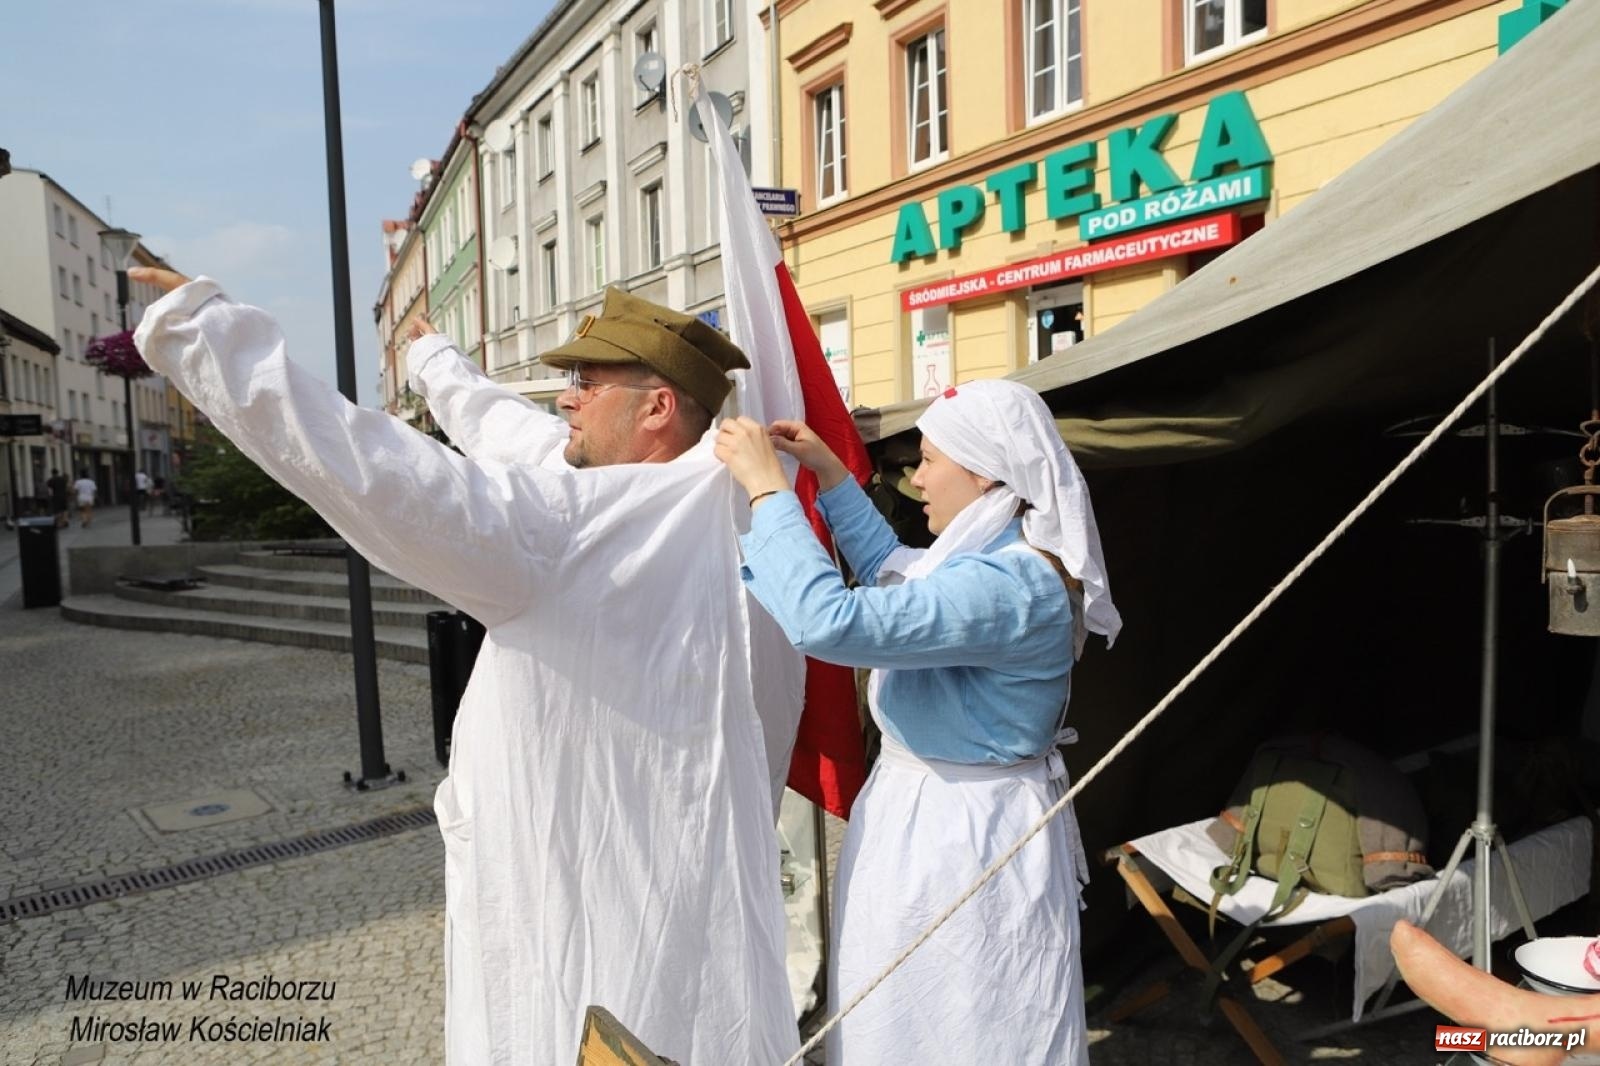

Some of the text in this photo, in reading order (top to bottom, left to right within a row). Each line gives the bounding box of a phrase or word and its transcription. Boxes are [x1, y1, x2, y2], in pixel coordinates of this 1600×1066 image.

[890, 90, 1274, 264] APTEKA
[1088, 177, 1251, 235] POD RÓŻAMI
[909, 277, 988, 306] ŚRÓDMIEJSKA
[996, 259, 1061, 286] CENTRUM
[1064, 223, 1220, 271] FARMACEUTYCZNE
